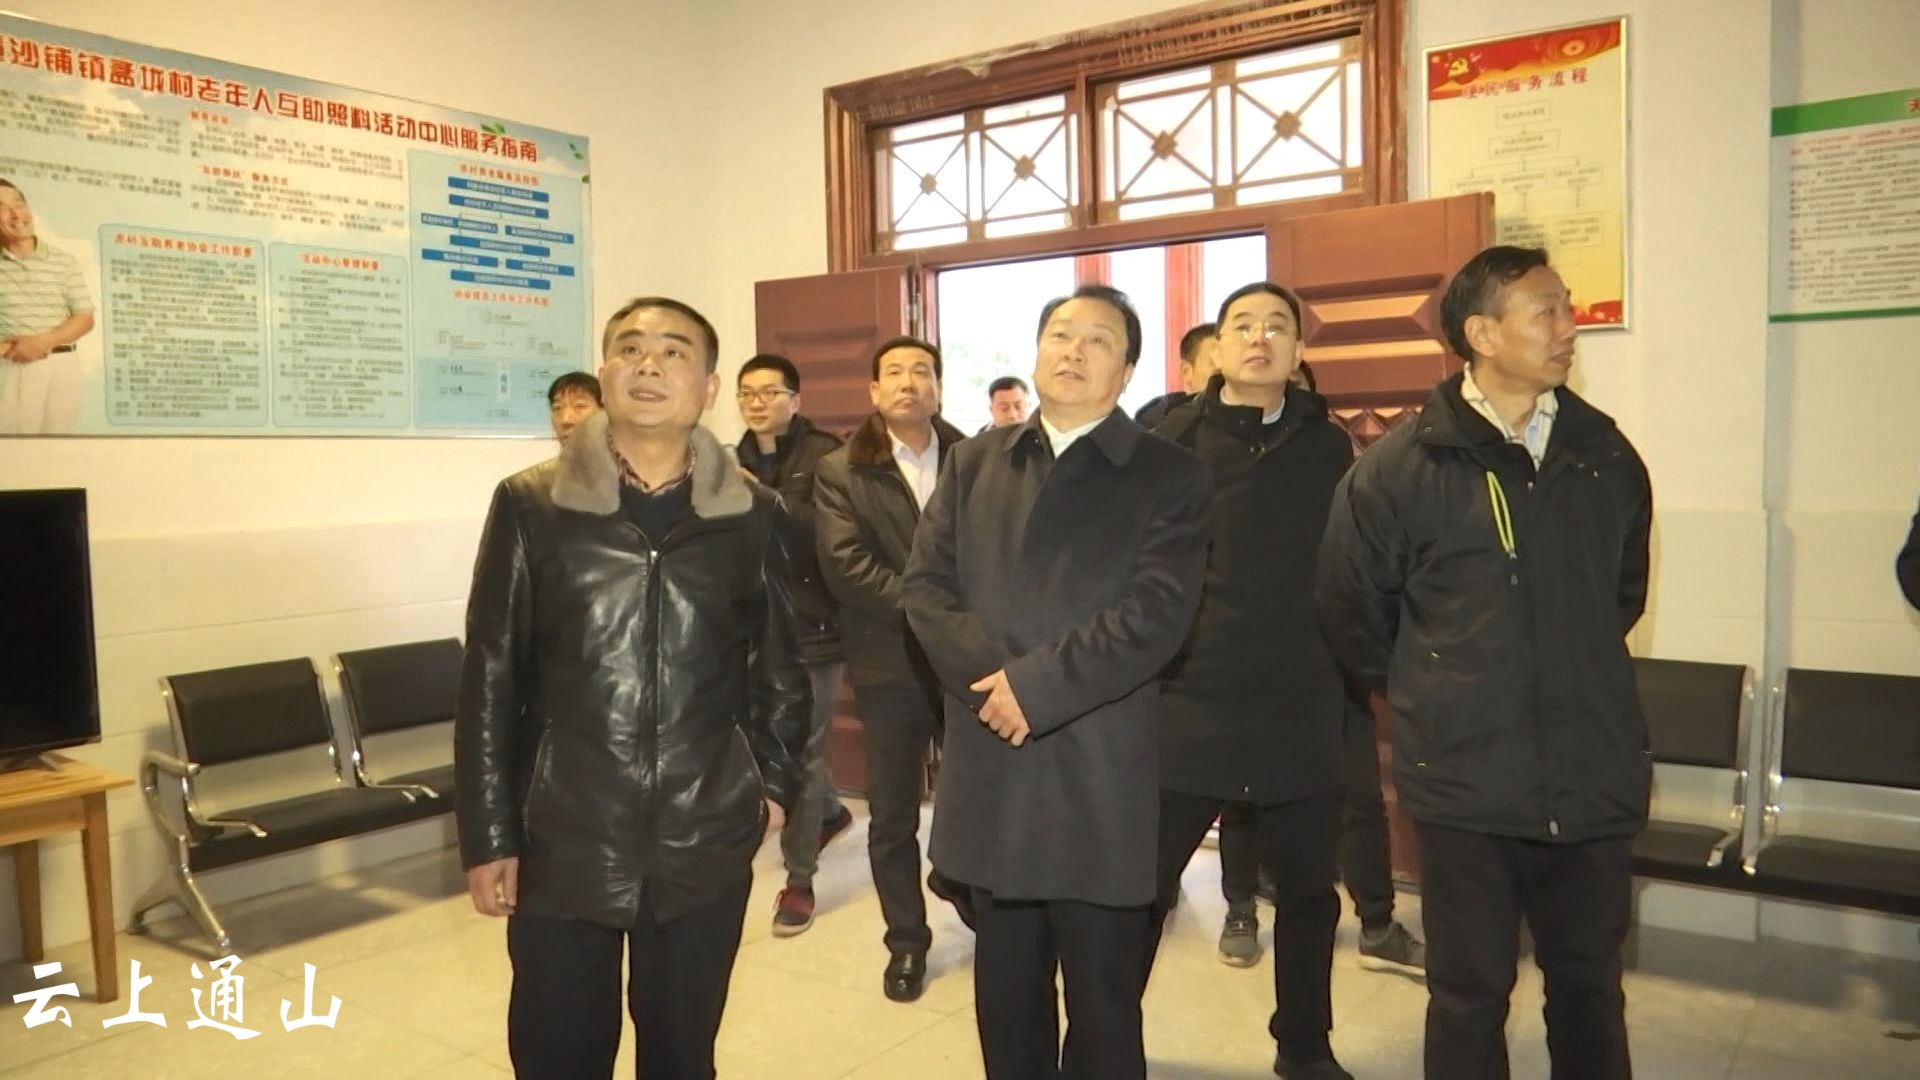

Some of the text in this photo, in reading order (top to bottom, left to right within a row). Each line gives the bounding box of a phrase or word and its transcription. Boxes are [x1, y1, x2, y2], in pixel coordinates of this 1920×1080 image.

[1463, 66, 1589, 99] 便民服务流程
